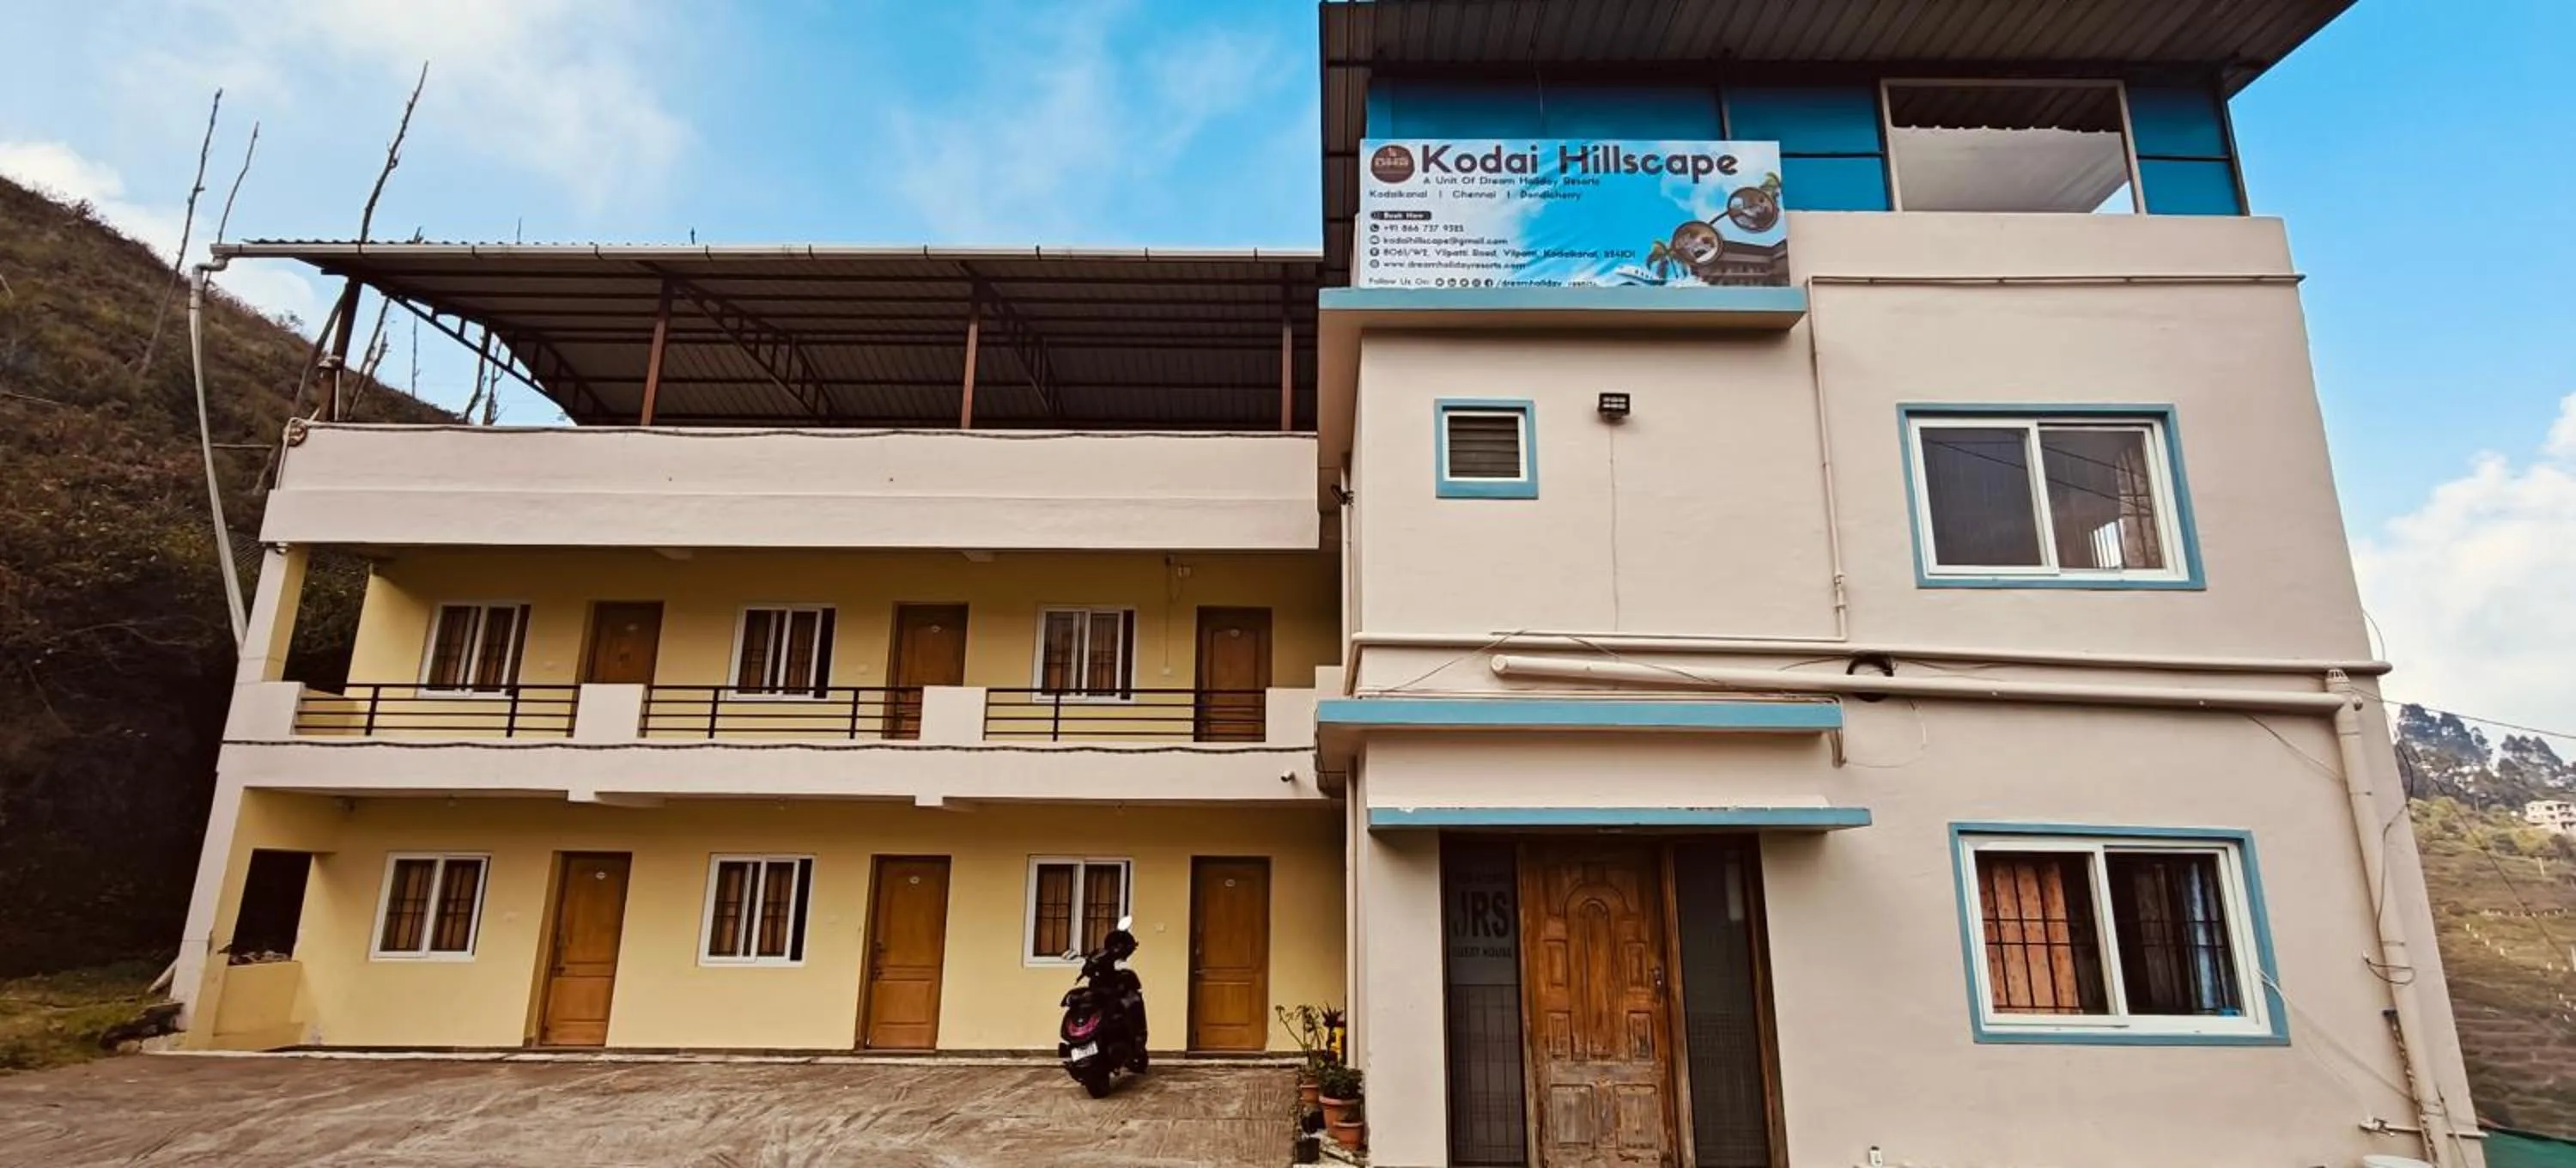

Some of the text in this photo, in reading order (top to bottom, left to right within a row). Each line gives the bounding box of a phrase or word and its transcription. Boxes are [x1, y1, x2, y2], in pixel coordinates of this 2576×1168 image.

[1422, 144, 1738, 184] Kodai Hillscape
[1423, 176, 1431, 185] A
[1436, 176, 1457, 185] Unit
[1461, 176, 1475, 185] Of
[1519, 177, 1558, 186] Holiday
[1564, 177, 1600, 186] Resorts
[1370, 190, 1428, 198] Kodaikanal
[1452, 190, 1497, 198] Chennai
[1520, 190, 1583, 201] Pondicherry
[1453, 891, 1509, 938] JRS
